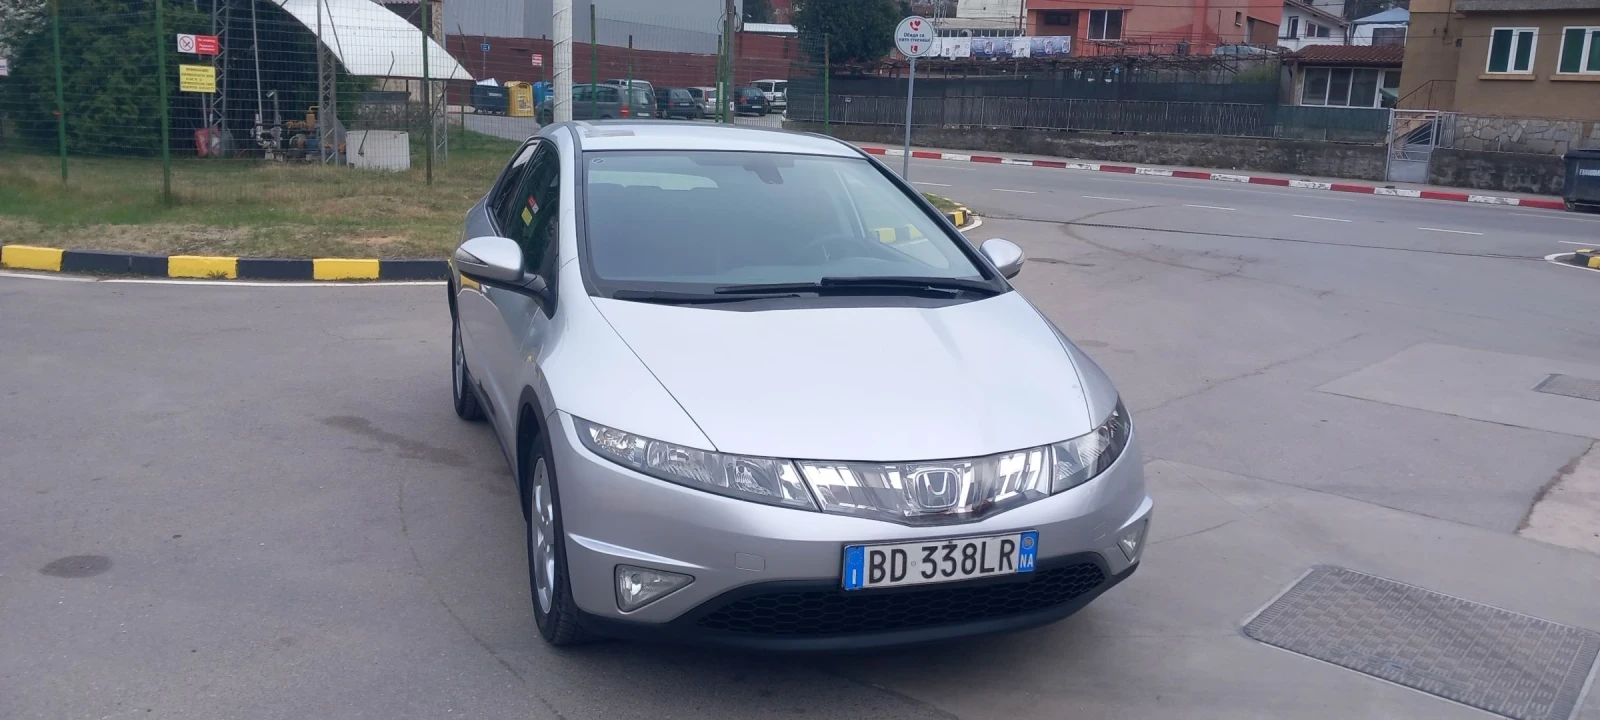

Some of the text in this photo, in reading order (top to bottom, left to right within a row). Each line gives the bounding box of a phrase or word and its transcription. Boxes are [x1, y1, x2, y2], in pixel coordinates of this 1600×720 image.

[868, 538, 1016, 584] BD 338LR
[1020, 553, 1034, 568] NA
